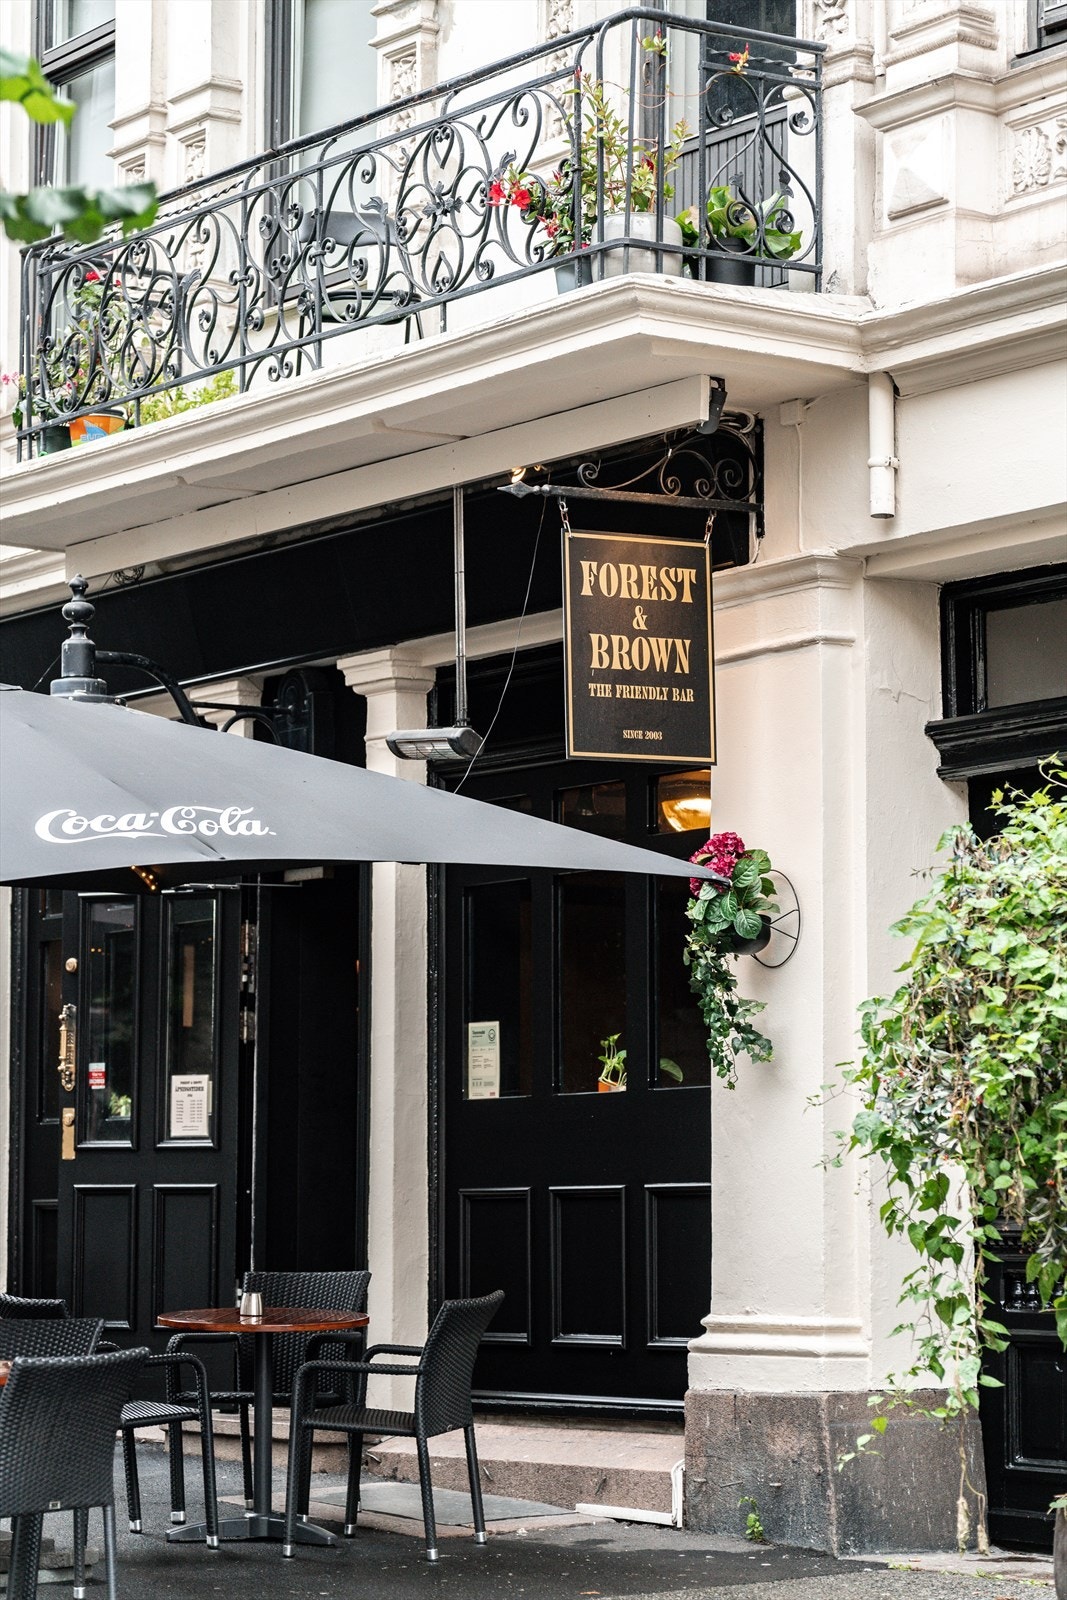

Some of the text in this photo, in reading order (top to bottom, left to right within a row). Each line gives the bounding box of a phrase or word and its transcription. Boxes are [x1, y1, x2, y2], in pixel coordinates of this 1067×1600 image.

[580, 561, 697, 604] FOREST
[632, 605, 648, 631] &
[589, 633, 691, 674] BROWN
[588, 683, 695, 702] THE FRIENDLY BAR
[622, 729, 663, 741] SINCE 2003
[34, 805, 276, 844] Coca-Cola
